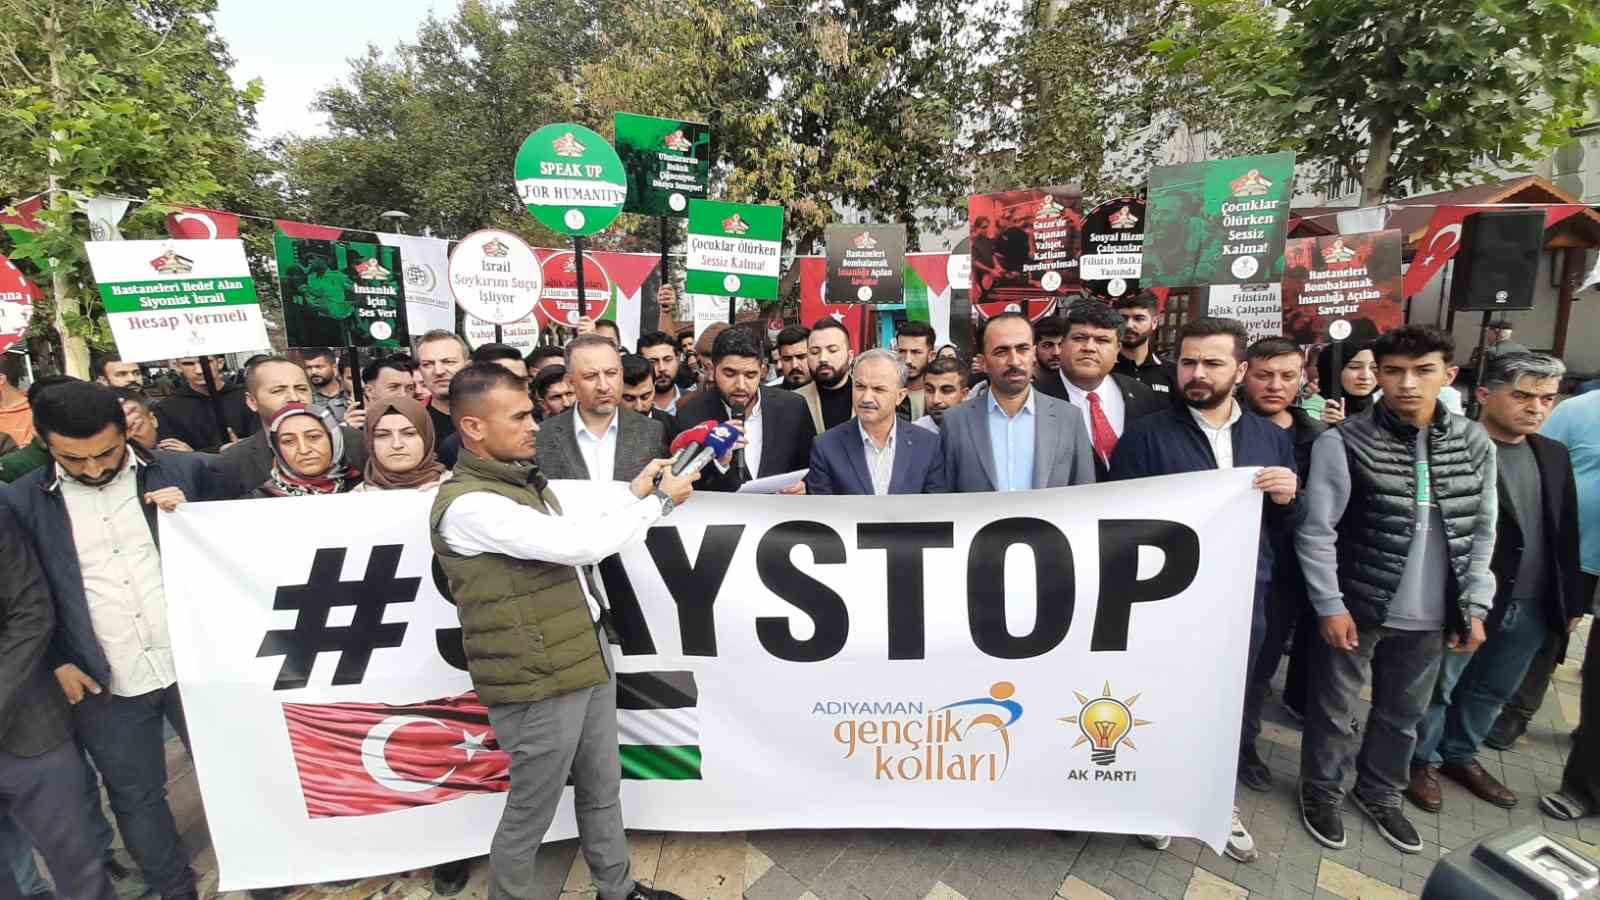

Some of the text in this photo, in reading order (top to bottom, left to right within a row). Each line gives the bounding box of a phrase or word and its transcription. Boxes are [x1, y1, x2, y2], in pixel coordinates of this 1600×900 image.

[540, 161, 603, 177] SPEAK UP
[525, 184, 620, 202] FOR HUMANITY
[1222, 199, 1279, 217] Çocuklar
[1223, 214, 1273, 227] Ölürken
[1034, 230, 1066, 241] Yaşanan
[1090, 232, 1119, 243] Sosyal
[1228, 229, 1264, 240] Sessiz
[692, 238, 777, 256] Çocuklar Ölürken
[1222, 242, 1268, 255] Kalma!
[1034, 251, 1066, 260] Katliam
[1082, 256, 1114, 266] Filistin
[482, 259, 511, 272] İsrail
[701, 255, 765, 271] Sessiz Kalma!
[1309, 265, 1368, 280] Hastaneleri
[112, 278, 243, 295] Hastaneleri Hedef Alan
[455, 273, 509, 288] Soykırım
[1304, 278, 1374, 292] Bombalamak
[354, 283, 397, 295] İnsanlık
[140, 292, 226, 308] Siyonist İsrail
[1232, 292, 1276, 303] Filistinli
[1298, 289, 1380, 305] İnsanlığa Açılan
[359, 308, 397, 318] Ses Ver!
[1318, 304, 1360, 316] Savaştır
[128, 309, 248, 330] Hesap Vermeli
[811, 702, 923, 715] ADIYAMAN
[833, 710, 963, 759] gençlik
[875, 744, 997, 782] kolları
[1067, 769, 1089, 781] AK
